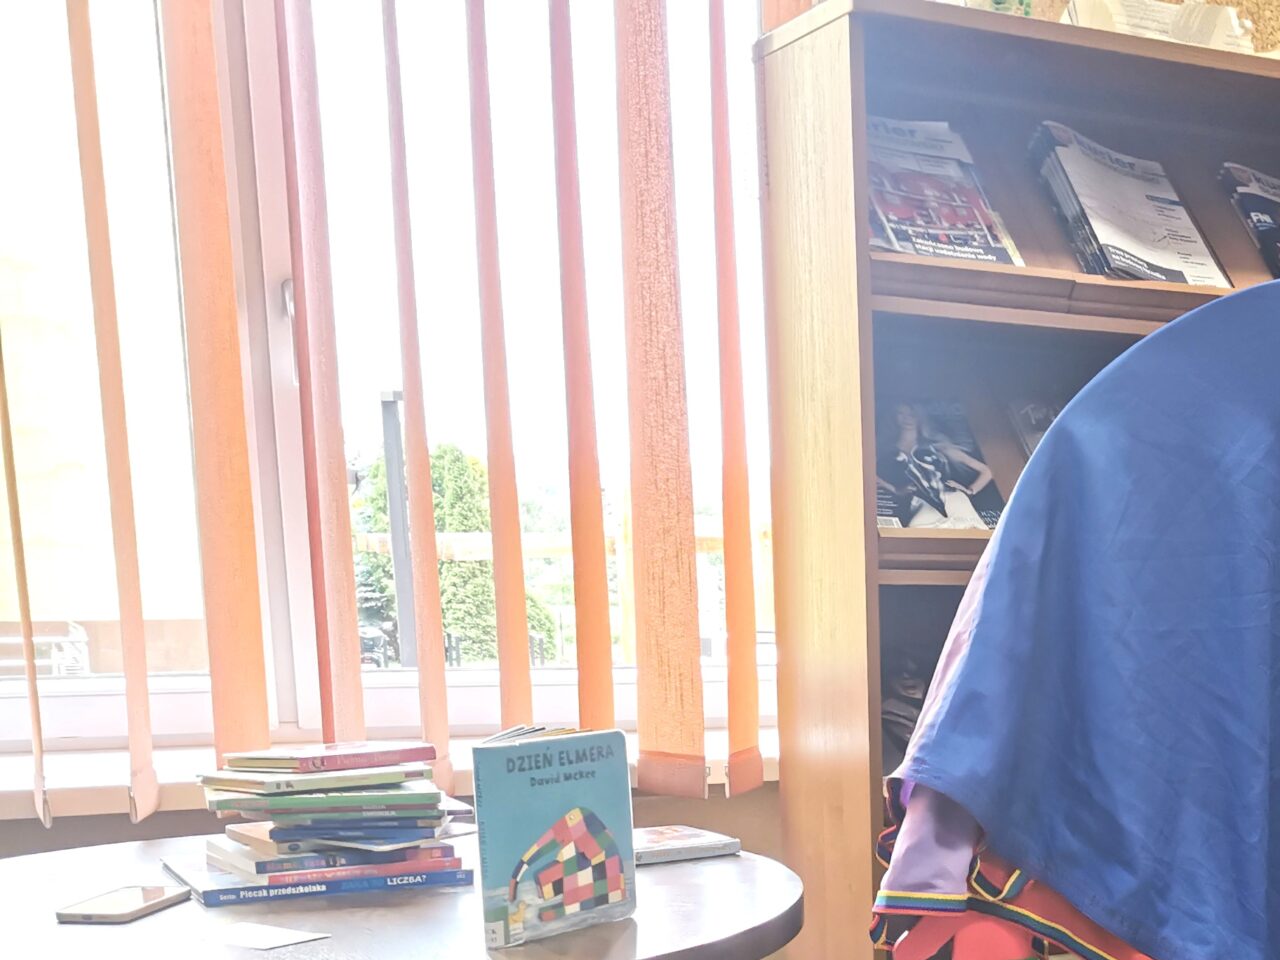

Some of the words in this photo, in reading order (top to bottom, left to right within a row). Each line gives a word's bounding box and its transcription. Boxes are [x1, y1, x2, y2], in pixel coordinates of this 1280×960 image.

[506, 746, 553, 773] DZIEŃ
[558, 744, 615, 767] ELMERA
[530, 774, 560, 787] David
[387, 874, 427, 886] LICZBA?
[240, 888, 269, 899] Plecak
[269, 883, 327, 897] przedszkolaka
